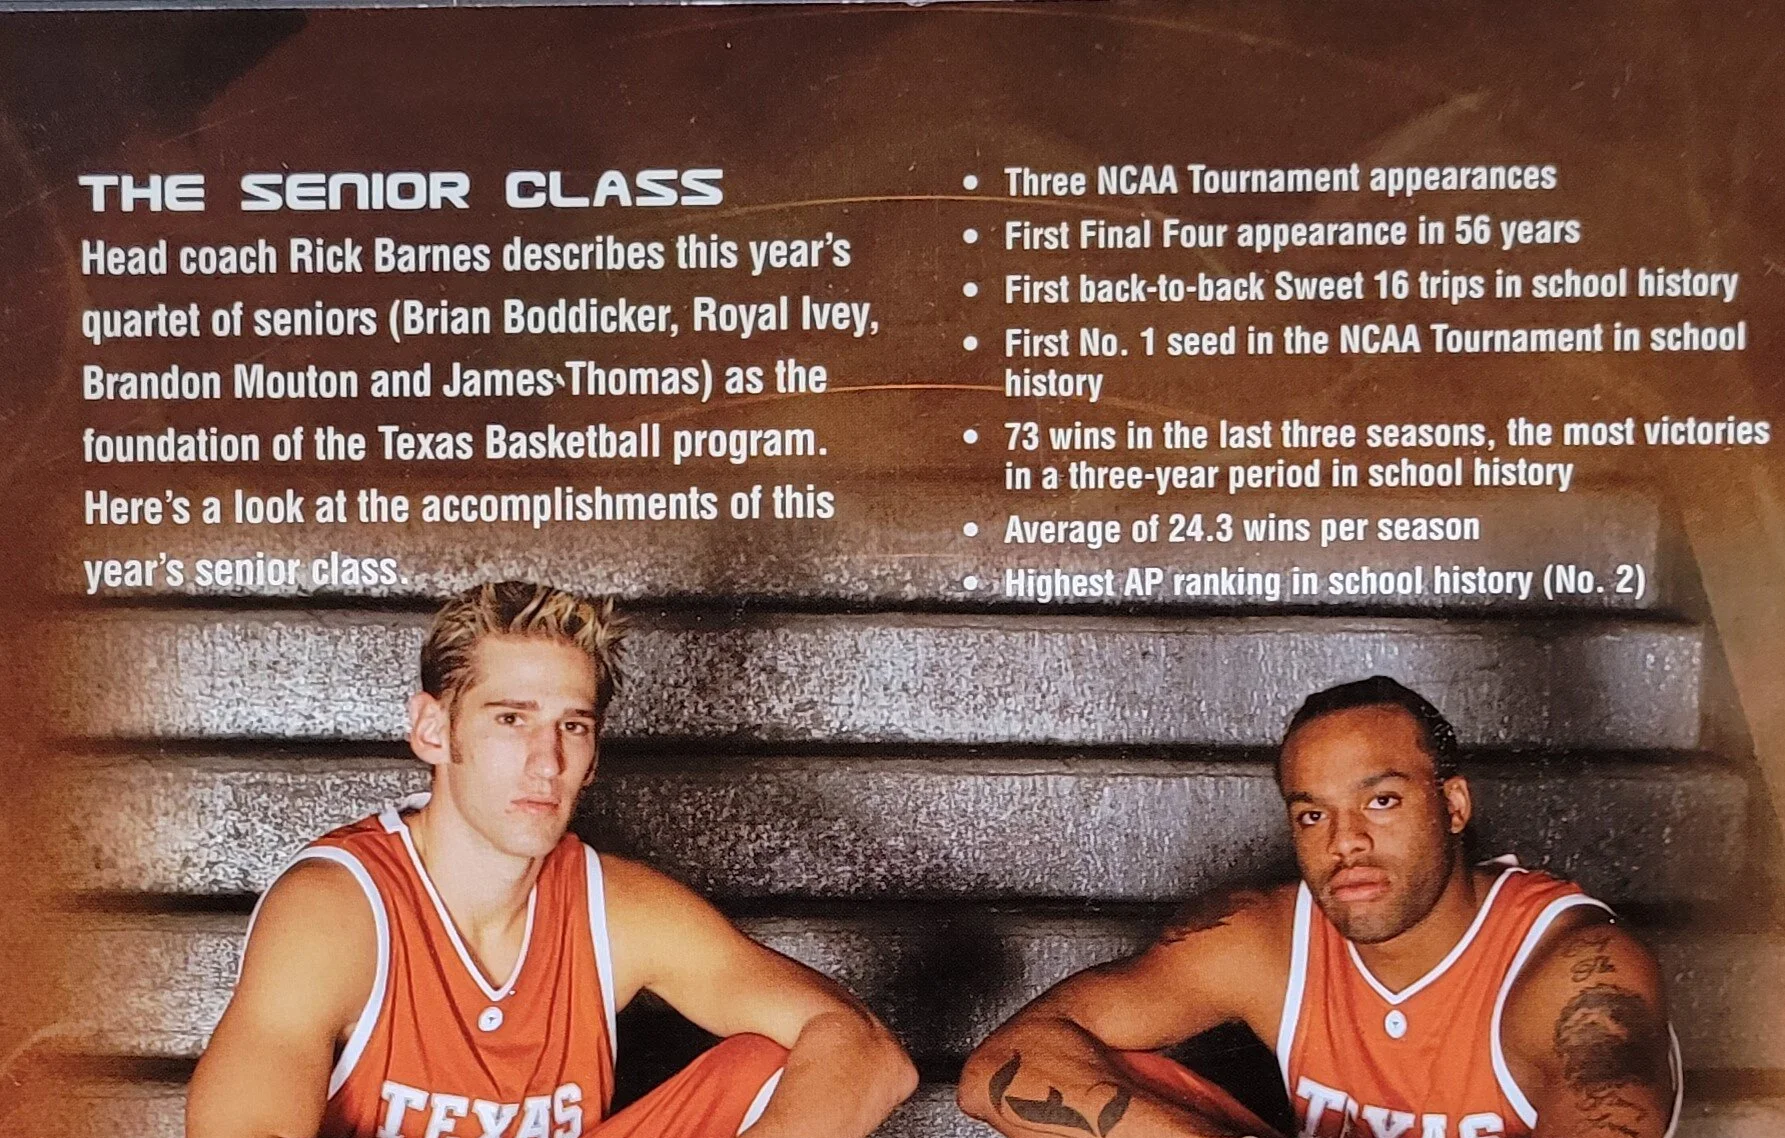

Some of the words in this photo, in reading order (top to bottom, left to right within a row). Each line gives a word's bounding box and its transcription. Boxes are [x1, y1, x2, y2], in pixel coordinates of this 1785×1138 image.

[78, 174, 205, 212] THE
[240, 171, 470, 211] SENIOR
[505, 168, 724, 209] CLASS
[1004, 167, 1086, 197] Three
[1097, 164, 1178, 195] NCAA
[1187, 163, 1360, 194] Tournament
[1369, 165, 1557, 198] appearances
[1005, 220, 1070, 250] First
[1080, 219, 1151, 249] Final
[1163, 218, 1228, 248] Four
[1237, 221, 1407, 253] appearance
[1418, 215, 1445, 245] in
[1455, 214, 1491, 245] 56
[1500, 219, 1581, 251] years
[82, 239, 167, 275] Head
[179, 238, 277, 275] coach
[290, 237, 363, 273] Rick
[374, 237, 491, 273] Barnes
[502, 235, 665, 272] describes
[675, 233, 738, 269] this
[749, 232, 851, 276] year's
[1005, 274, 1070, 304] First
[1079, 271, 1265, 303] back-to-back
[1275, 270, 1364, 301] Sweet
[1374, 269, 1410, 300] 16
[1418, 269, 1485, 305] trips
[1495, 268, 1522, 298] in
[1532, 267, 1627, 298] school
[1638, 267, 1739, 303] history
[82, 303, 200, 344] quartet
[211, 301, 244, 337] of
[253, 300, 377, 337] seniors
[389, 299, 491, 343] (Brian
[504, 297, 679, 338] Boddicker,
[693, 295, 788, 339] Royal
[802, 295, 879, 338] Ivey,
[1005, 328, 1070, 357] First
[1080, 327, 1128, 357] No.
[1140, 327, 1154, 356] 1
[1167, 326, 1236, 356] seed
[1247, 325, 1274, 355] in
[1283, 325, 1329, 355] the
[1340, 323, 1421, 354] NCAA
[1430, 323, 1604, 353] Tournament
[1614, 322, 1640, 352] in
[1650, 321, 1746, 352] school
[83, 364, 221, 400] Brandon
[234, 363, 358, 399] Mouton
[370, 362, 431, 398] and
[442, 362, 554, 398] James
[565, 359, 713, 403] Thomas)
[725, 366, 764, 394] as
[775, 358, 827, 394] the
[1005, 368, 1104, 403] history
[82, 427, 260, 463] foundation
[272, 426, 304, 462] of
[314, 426, 366, 461] the
[377, 425, 474, 461] Texas
[486, 422, 660, 460] Basketball
[673, 428, 827, 465] program.
[1004, 421, 1040, 451] 73
[1049, 421, 1116, 450] wins
[1127, 420, 1153, 450] in
[1163, 420, 1208, 449] the
[1220, 420, 1272, 449] last
[1281, 419, 1356, 448] three
[1366, 423, 1495, 451] seasons,
[1507, 417, 1553, 446] the
[1563, 417, 1635, 446] most
[1644, 415, 1770, 446] victories
[1005, 461, 1031, 490] in
[1042, 466, 1058, 490] a
[1068, 460, 1219, 496] three-year
[1229, 458, 1321, 495] period
[1332, 458, 1358, 487] in
[1368, 458, 1463, 487] school
[1474, 458, 1574, 492] history
[85, 489, 191, 525] Here's
[202, 496, 221, 524] a
[235, 488, 305, 524] look
[315, 489, 347, 524] at
[357, 488, 409, 523] the
[422, 486, 718, 529] accomplishments
[730, 484, 762, 520] of
[772, 483, 835, 519] this
[1004, 515, 1121, 550] Average
[1132, 513, 1159, 543] of
[1168, 513, 1233, 543] 24.3
[1243, 513, 1311, 542] wins
[1321, 518, 1369, 548] per
[1377, 517, 1480, 541] season
[84, 552, 185, 595] year's
[195, 551, 303, 586] senior
[311, 550, 410, 586] class.
[1005, 568, 1115, 603] Highest
[1123, 567, 1164, 597] AP
[1173, 566, 1281, 602] ranking
[1292, 566, 1318, 595] in
[1328, 565, 1423, 595] school
[1434, 565, 1533, 600] history
[1543, 564, 1604, 600] (No.
[1615, 564, 1646, 600] 2)
